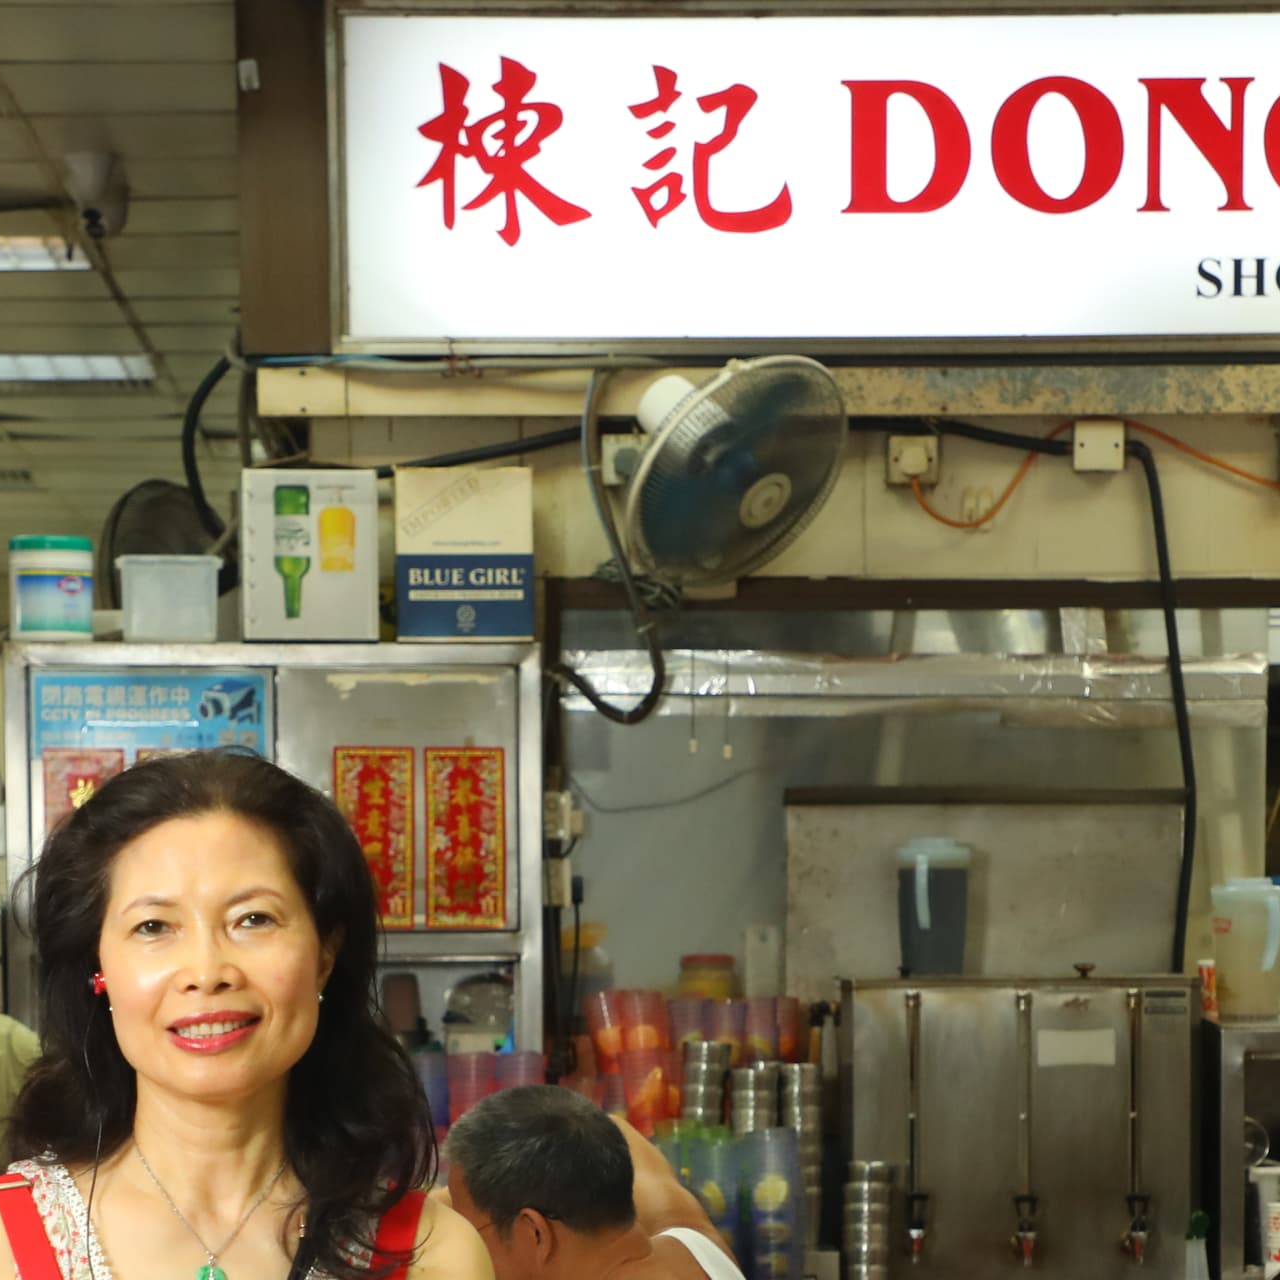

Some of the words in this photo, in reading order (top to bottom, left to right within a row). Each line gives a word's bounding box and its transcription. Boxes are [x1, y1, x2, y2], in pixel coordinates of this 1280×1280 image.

[416, 55, 793, 247] 棟記
[408, 568, 465, 586] BLUE
[469, 567, 524, 586] GIRL
